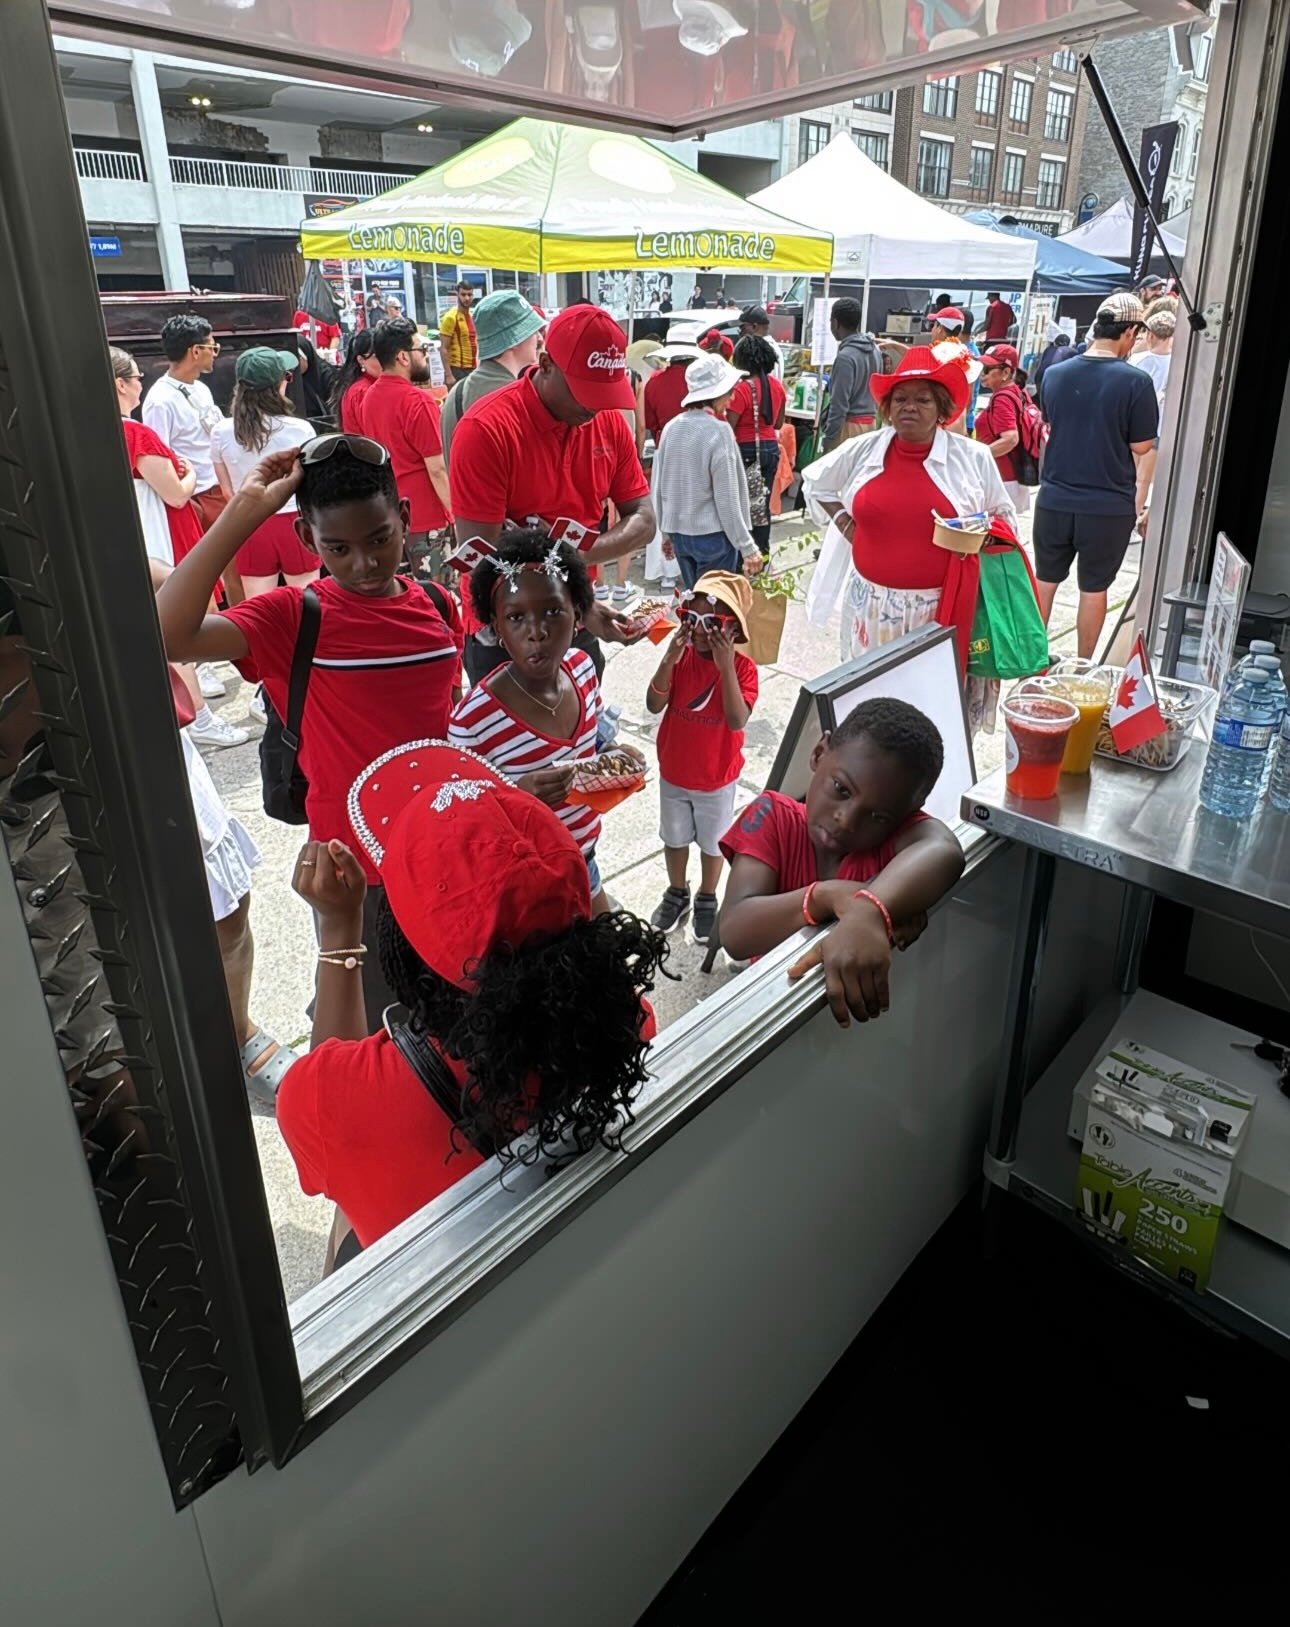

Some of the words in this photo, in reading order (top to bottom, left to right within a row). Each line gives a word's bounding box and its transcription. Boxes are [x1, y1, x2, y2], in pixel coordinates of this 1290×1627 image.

[349, 223, 465, 256] Lemonade
[634, 226, 776, 261] Lemonade
[1094, 1153, 1133, 1178] Table
[1112, 1167, 1199, 1205] Accents
[1138, 1197, 1188, 1235] 250
